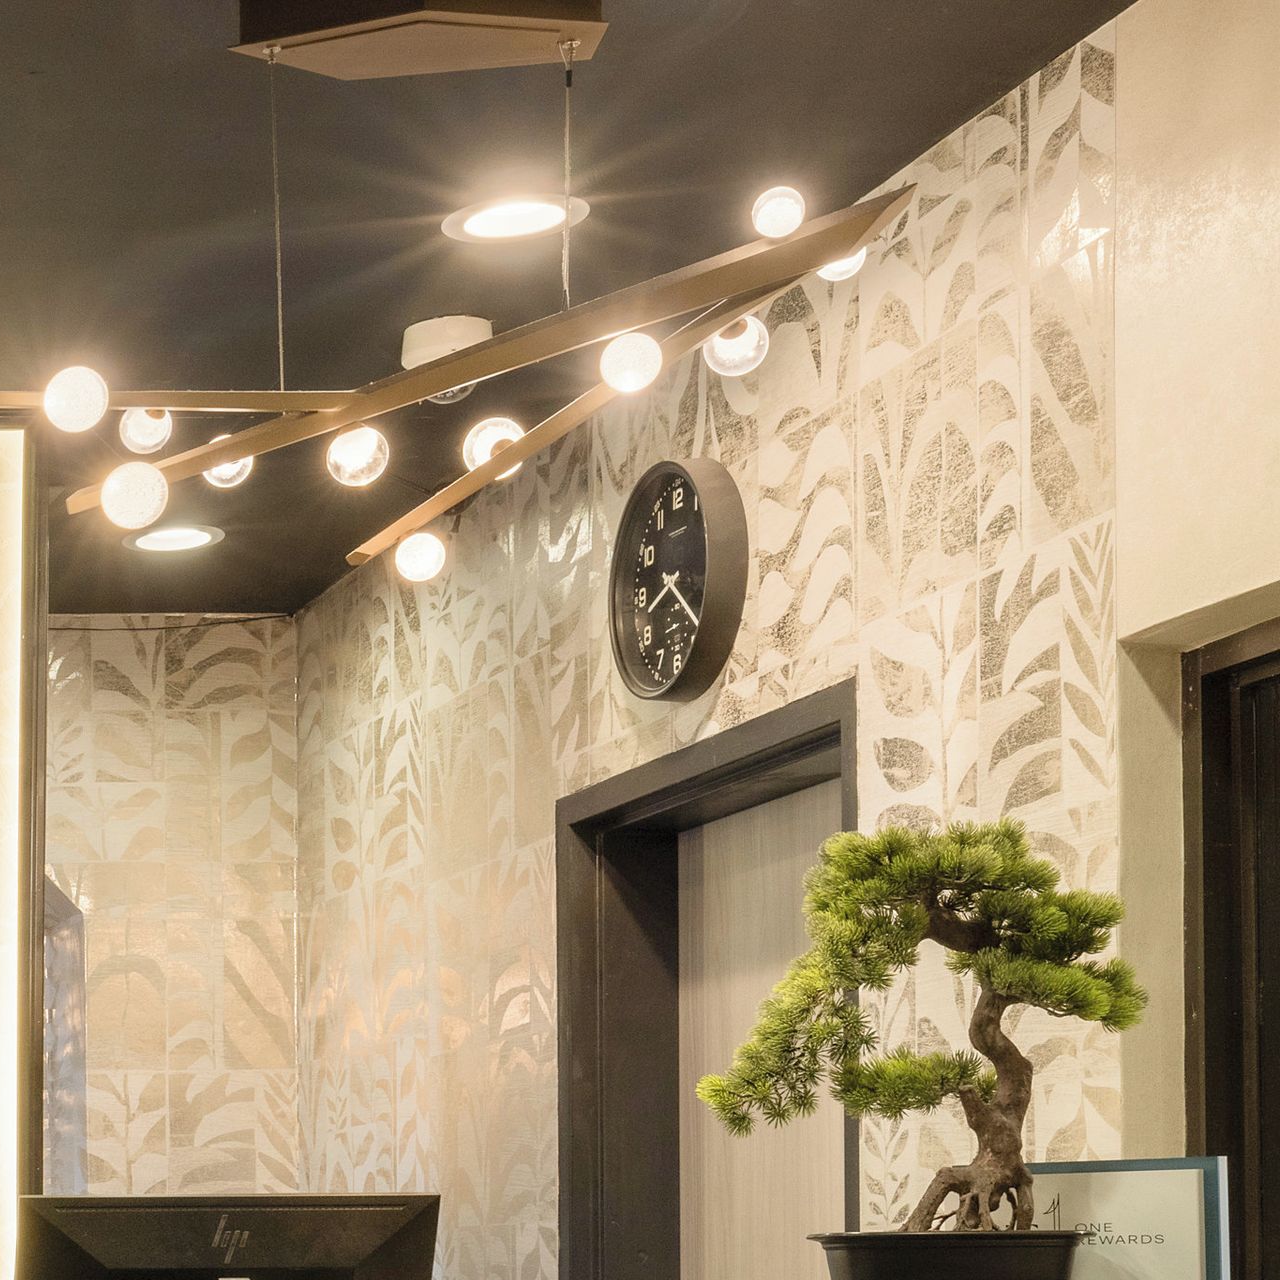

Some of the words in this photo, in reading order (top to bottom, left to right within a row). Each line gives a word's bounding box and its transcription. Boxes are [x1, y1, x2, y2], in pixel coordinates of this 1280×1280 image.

[672, 487, 684, 511] 12
[657, 509, 664, 531] 11
[644, 545, 655, 568] 10
[639, 587, 647, 608] 9
[643, 625, 652, 646] 8
[656, 648, 665, 670] 7
[673, 653, 682, 675] 6
[1074, 1222, 1113, 1232] ONE
